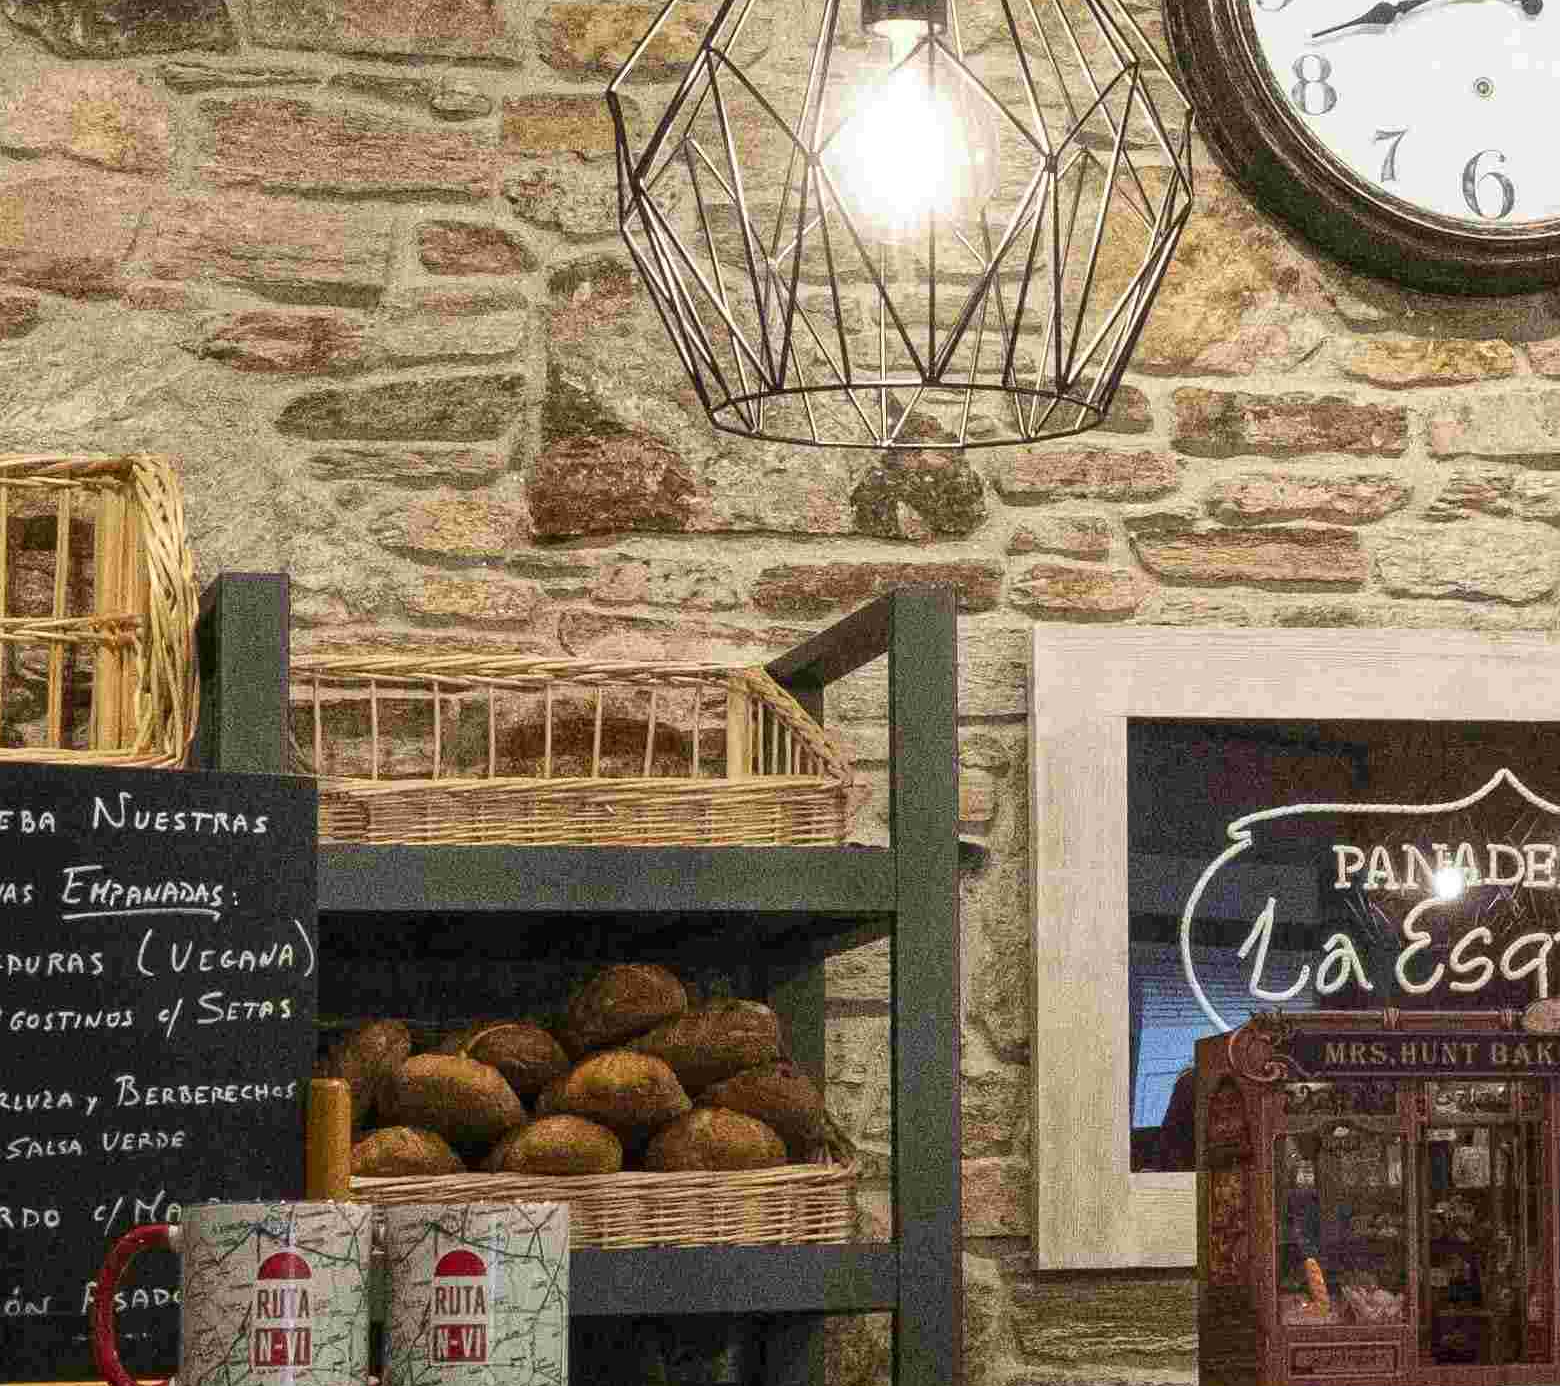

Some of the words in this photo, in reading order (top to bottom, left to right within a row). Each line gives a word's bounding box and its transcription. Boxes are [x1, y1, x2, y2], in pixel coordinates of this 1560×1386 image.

[1291, 53, 1338, 116] 8
[1373, 128, 1408, 183] 7
[1461, 149, 1516, 222] 6
[93, 791, 270, 834] NUESTRAS
[1238, 897, 1373, 1001] La
[197, 991, 292, 1024] SETAS
[115, 1074, 298, 1108] BERBERECHOS
[5, 1137, 83, 1160] SALSA
[103, 1130, 186, 1152] VERDE
[256, 1288, 311, 1320] RUTA
[434, 1285, 487, 1317] RUTA
